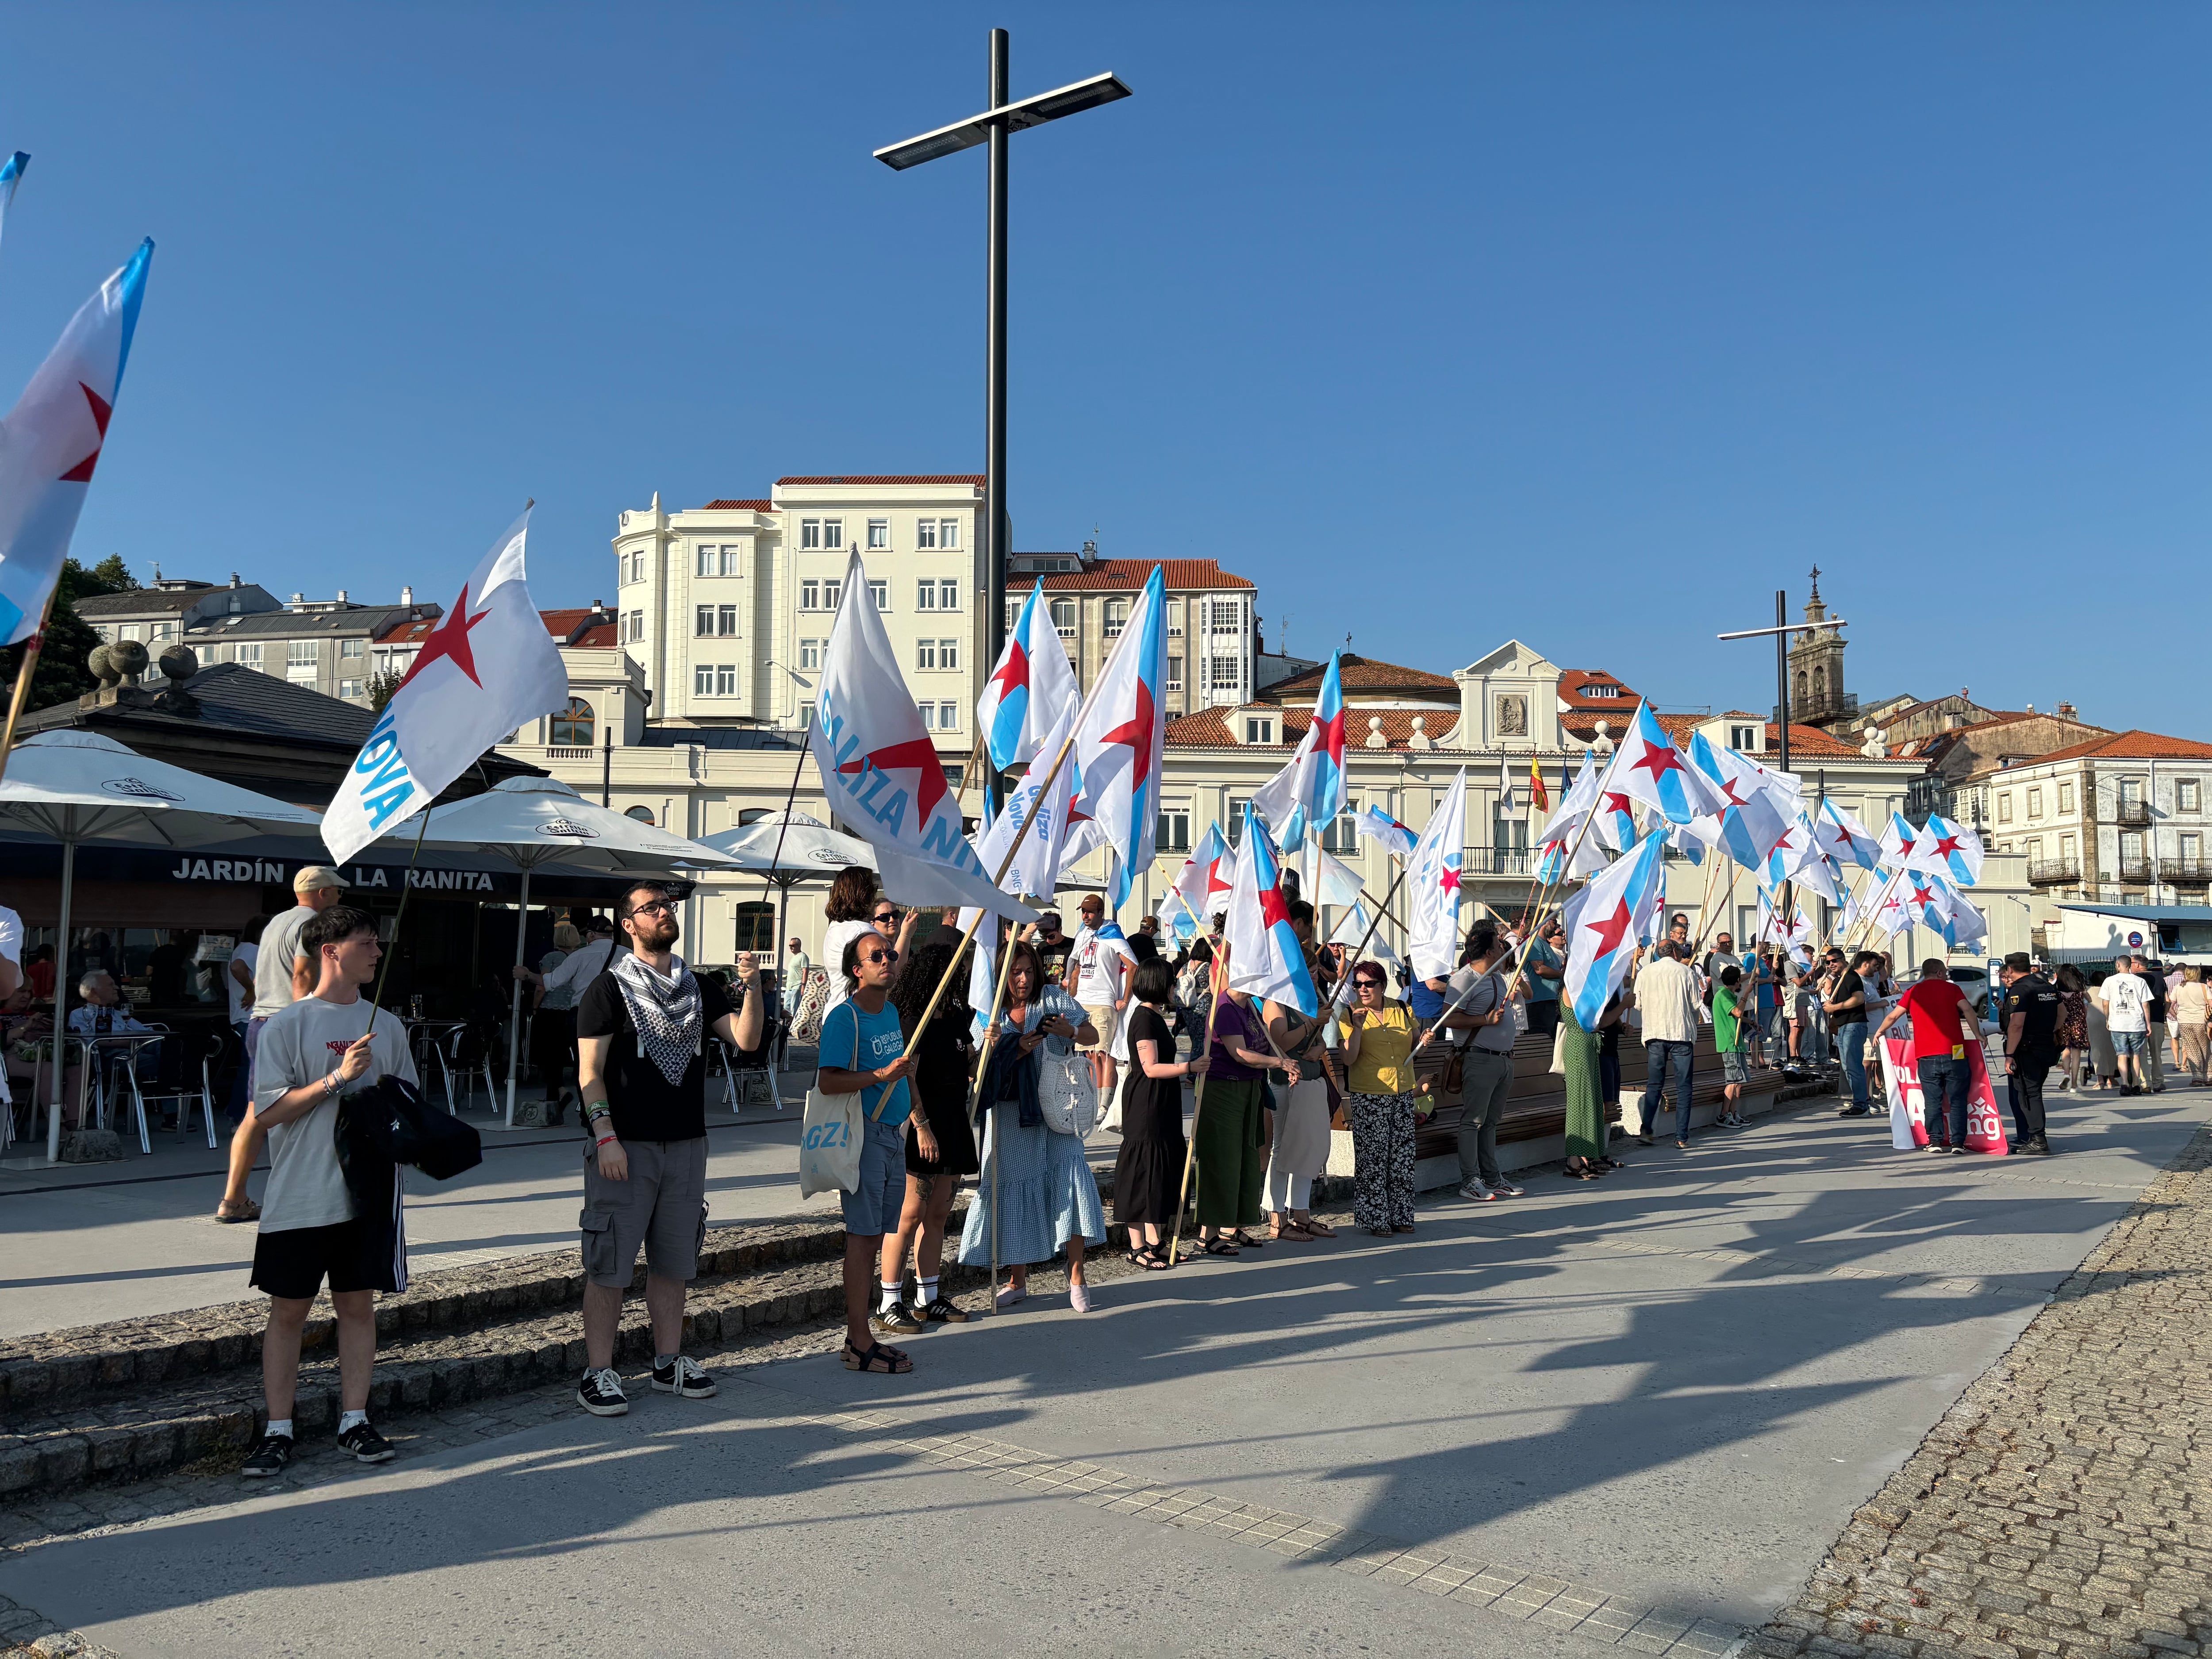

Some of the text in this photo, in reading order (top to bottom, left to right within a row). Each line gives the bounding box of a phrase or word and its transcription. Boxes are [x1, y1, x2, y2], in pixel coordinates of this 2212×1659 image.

[1008, 791, 1025, 830] Nova
[172, 858, 494, 891] JARDÍN LA RANITA
[1011, 869, 1022, 889] BNG
